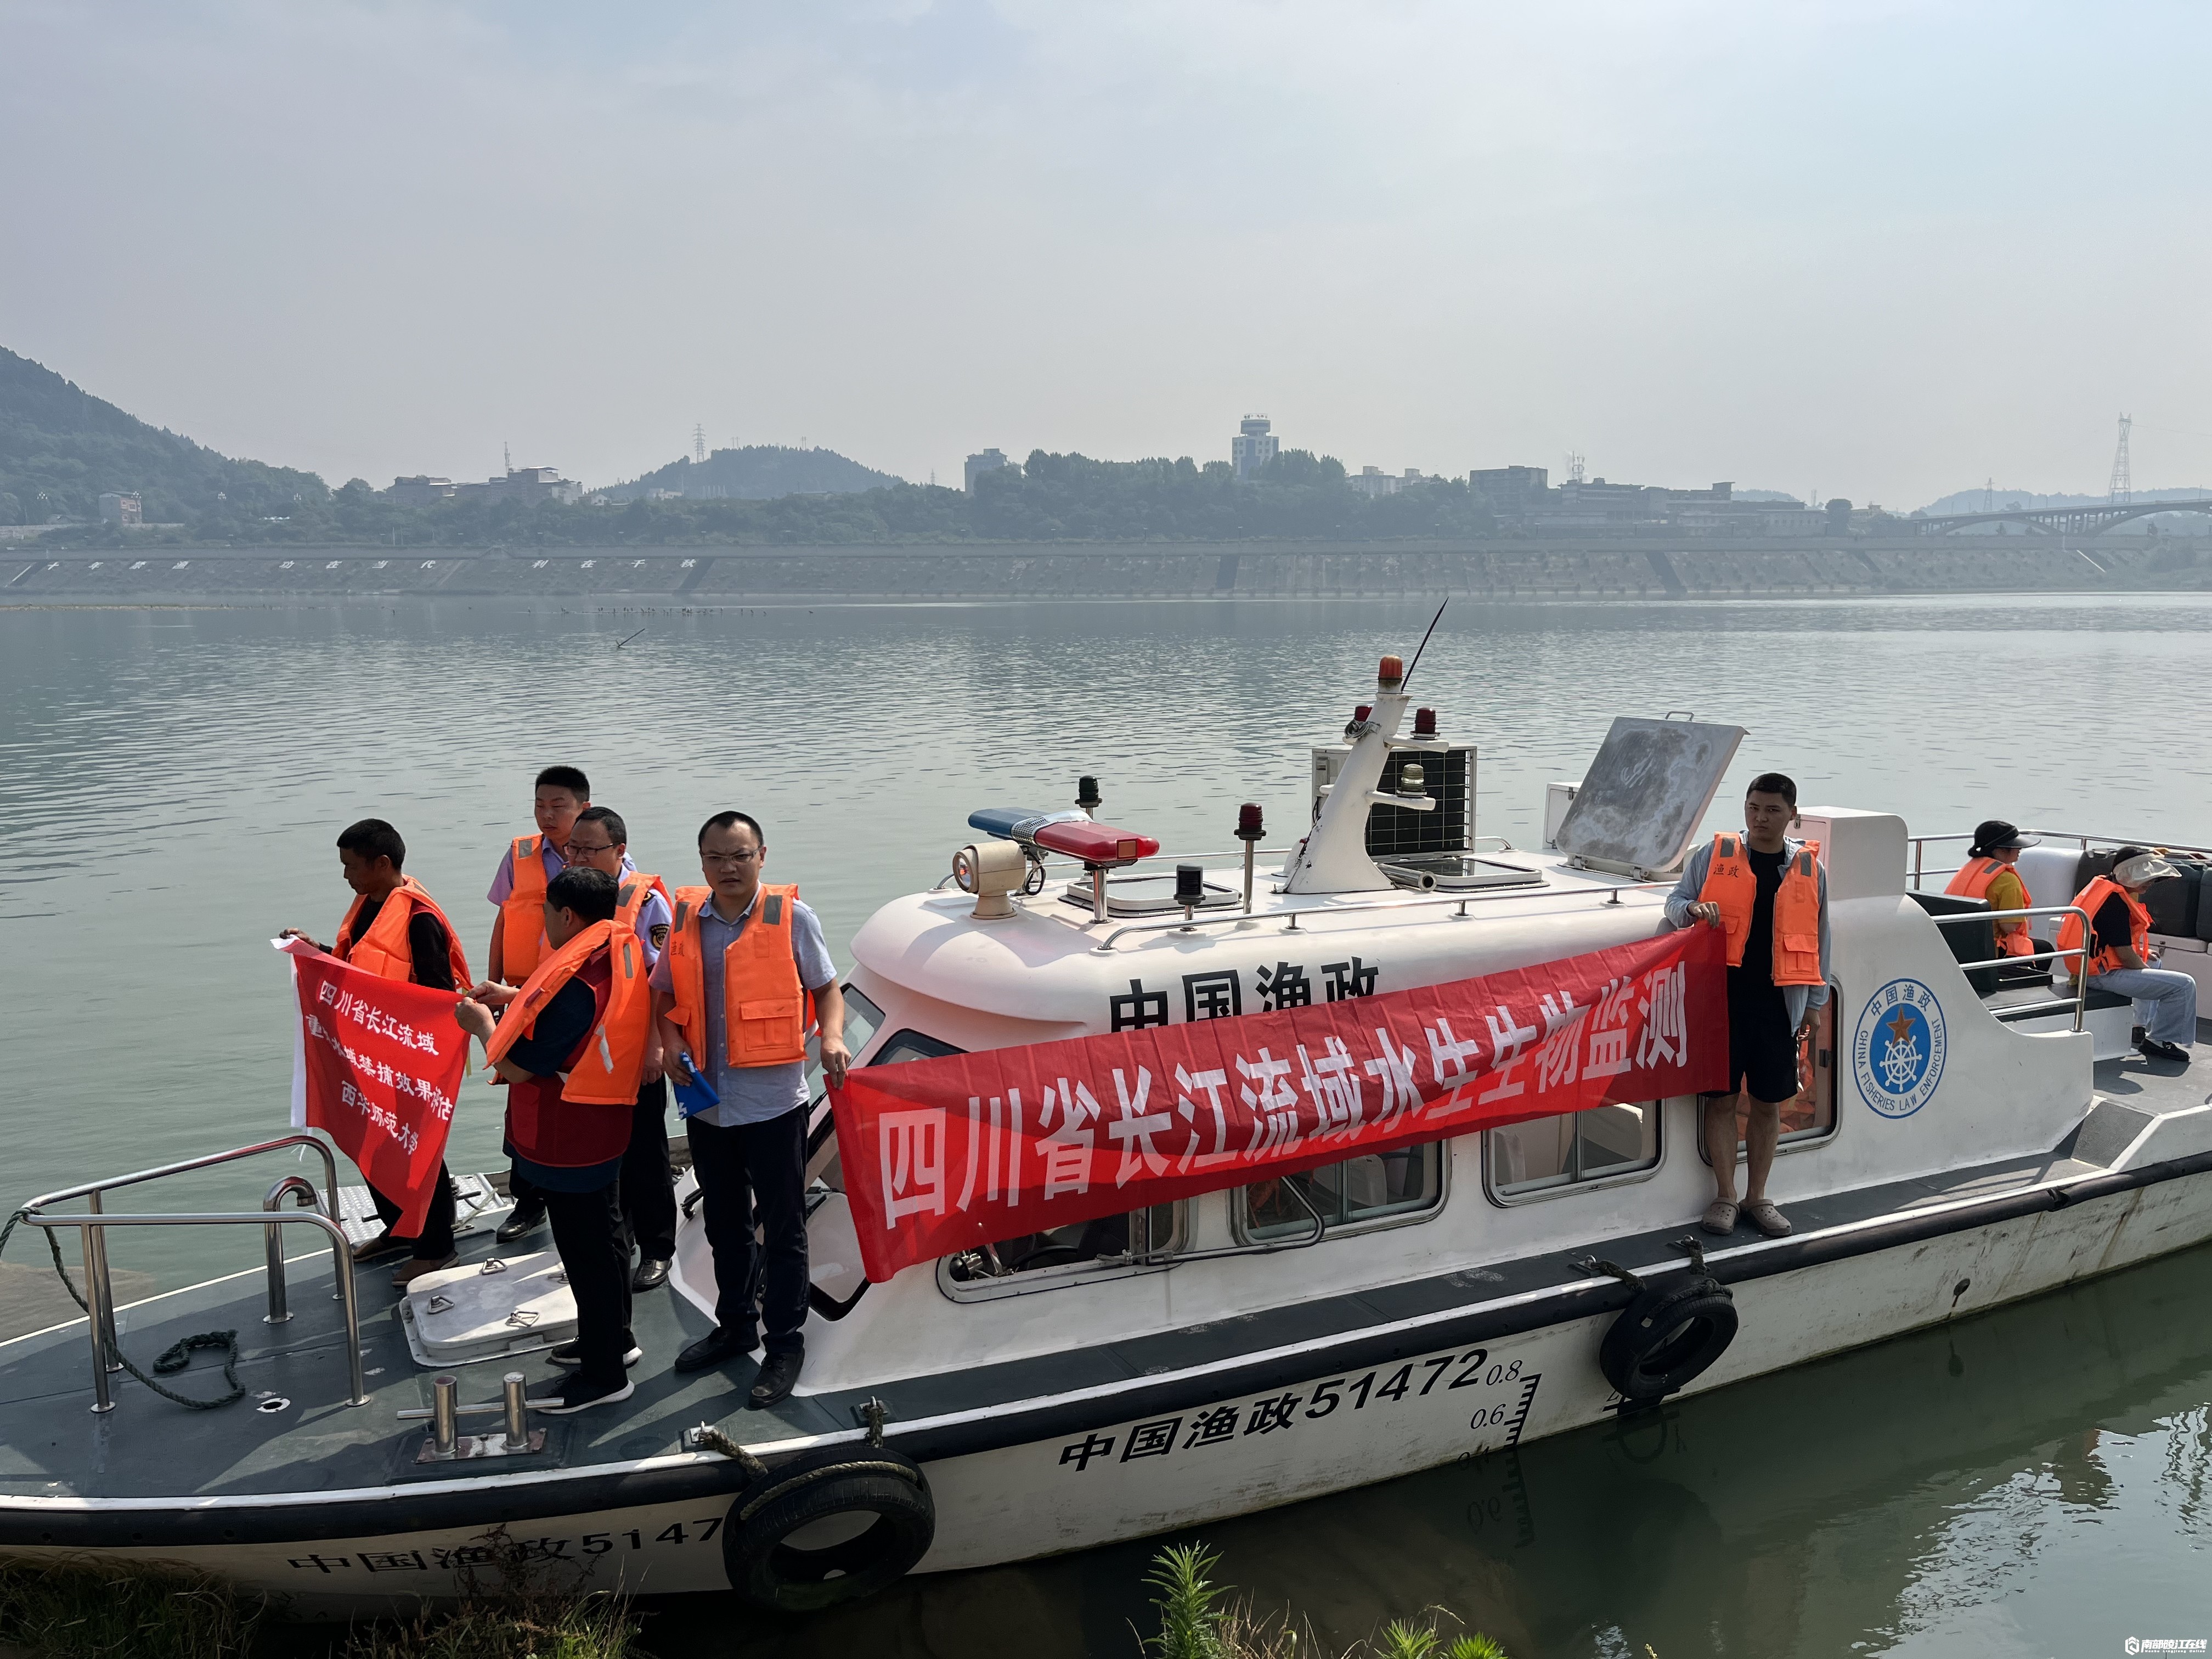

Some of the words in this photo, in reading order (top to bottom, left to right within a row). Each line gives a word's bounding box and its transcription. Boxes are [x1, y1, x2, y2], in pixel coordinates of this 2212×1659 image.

[1713, 863, 1740, 878] 渔政
[1109, 956, 1379, 1033] 中国渔政
[1870, 984, 1932, 1017] 中国渔政
[319, 980, 439, 1056] 四川省长江流域
[1858, 1030, 1869, 1069] CHINA
[1919, 1018, 1943, 1097] ENFORCEMENT
[879, 961, 1688, 1229] 四川省长江流域水生生物监测
[1861, 1071, 1895, 1111] FISHERIES
[1899, 1092, 1917, 1111] LAW
[342, 1080, 419, 1155] 西华师范大学
[1486, 1359, 1523, 1386] 0.8
[1058, 1348, 1488, 1472] 中国渔政51472
[1470, 1403, 1506, 1430] 0.6
